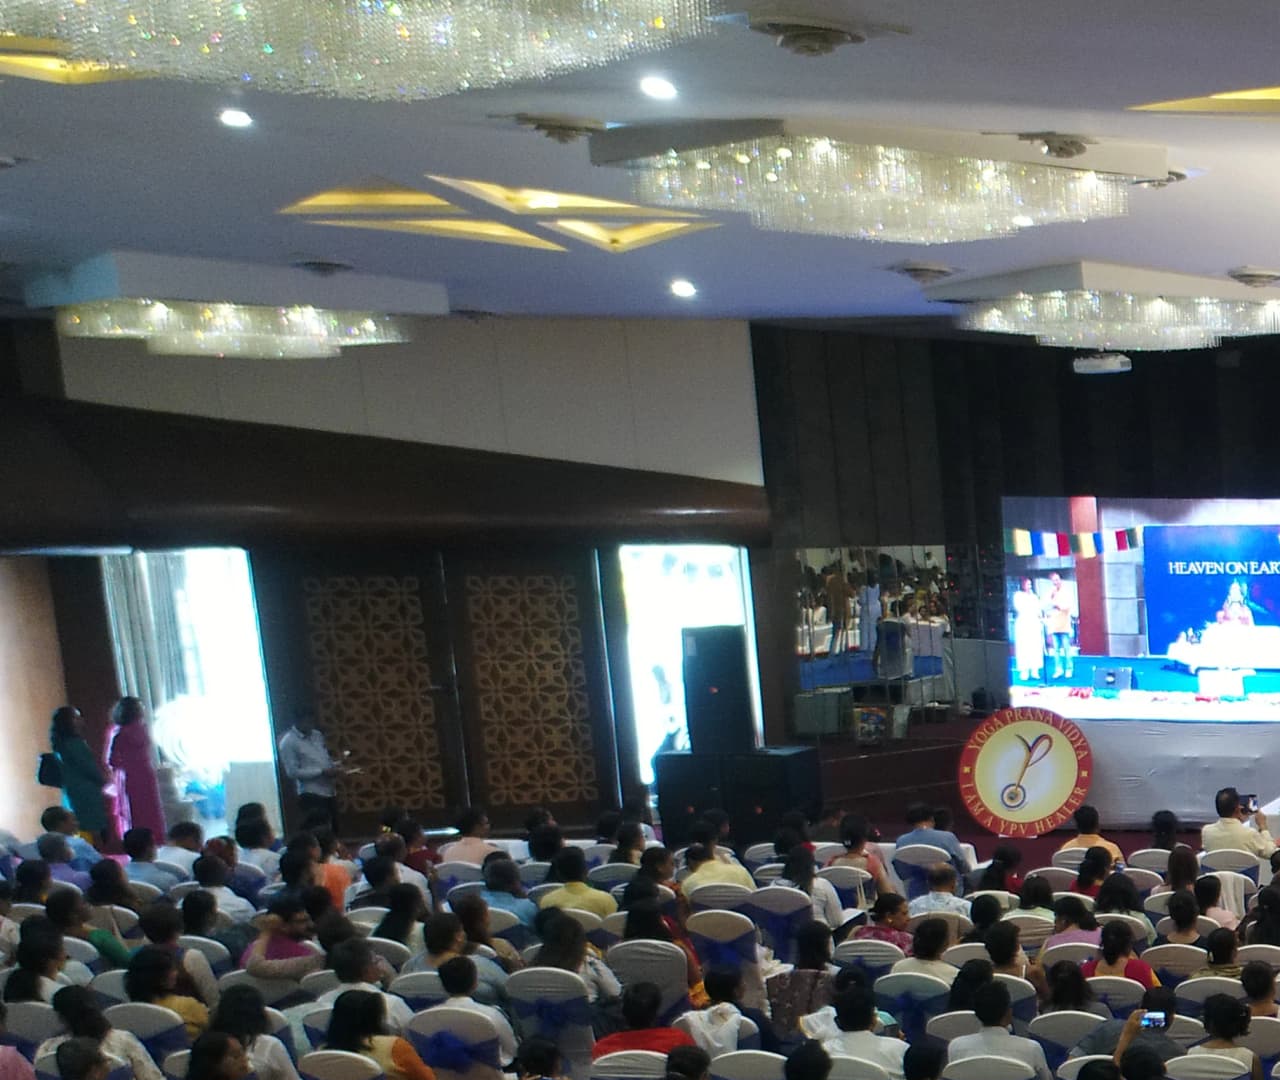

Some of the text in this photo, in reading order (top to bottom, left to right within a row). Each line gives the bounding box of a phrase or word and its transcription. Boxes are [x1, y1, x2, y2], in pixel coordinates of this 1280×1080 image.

[1168, 561, 1224, 575] HEAVEN
[1226, 561, 1249, 575] ON
[968, 709, 1088, 761] YOGA PRANA VIDYA
[965, 793, 983, 816] AM
[983, 816, 993, 828] A
[998, 822, 1029, 835] YPV
[1035, 786, 1088, 833] HEALER
